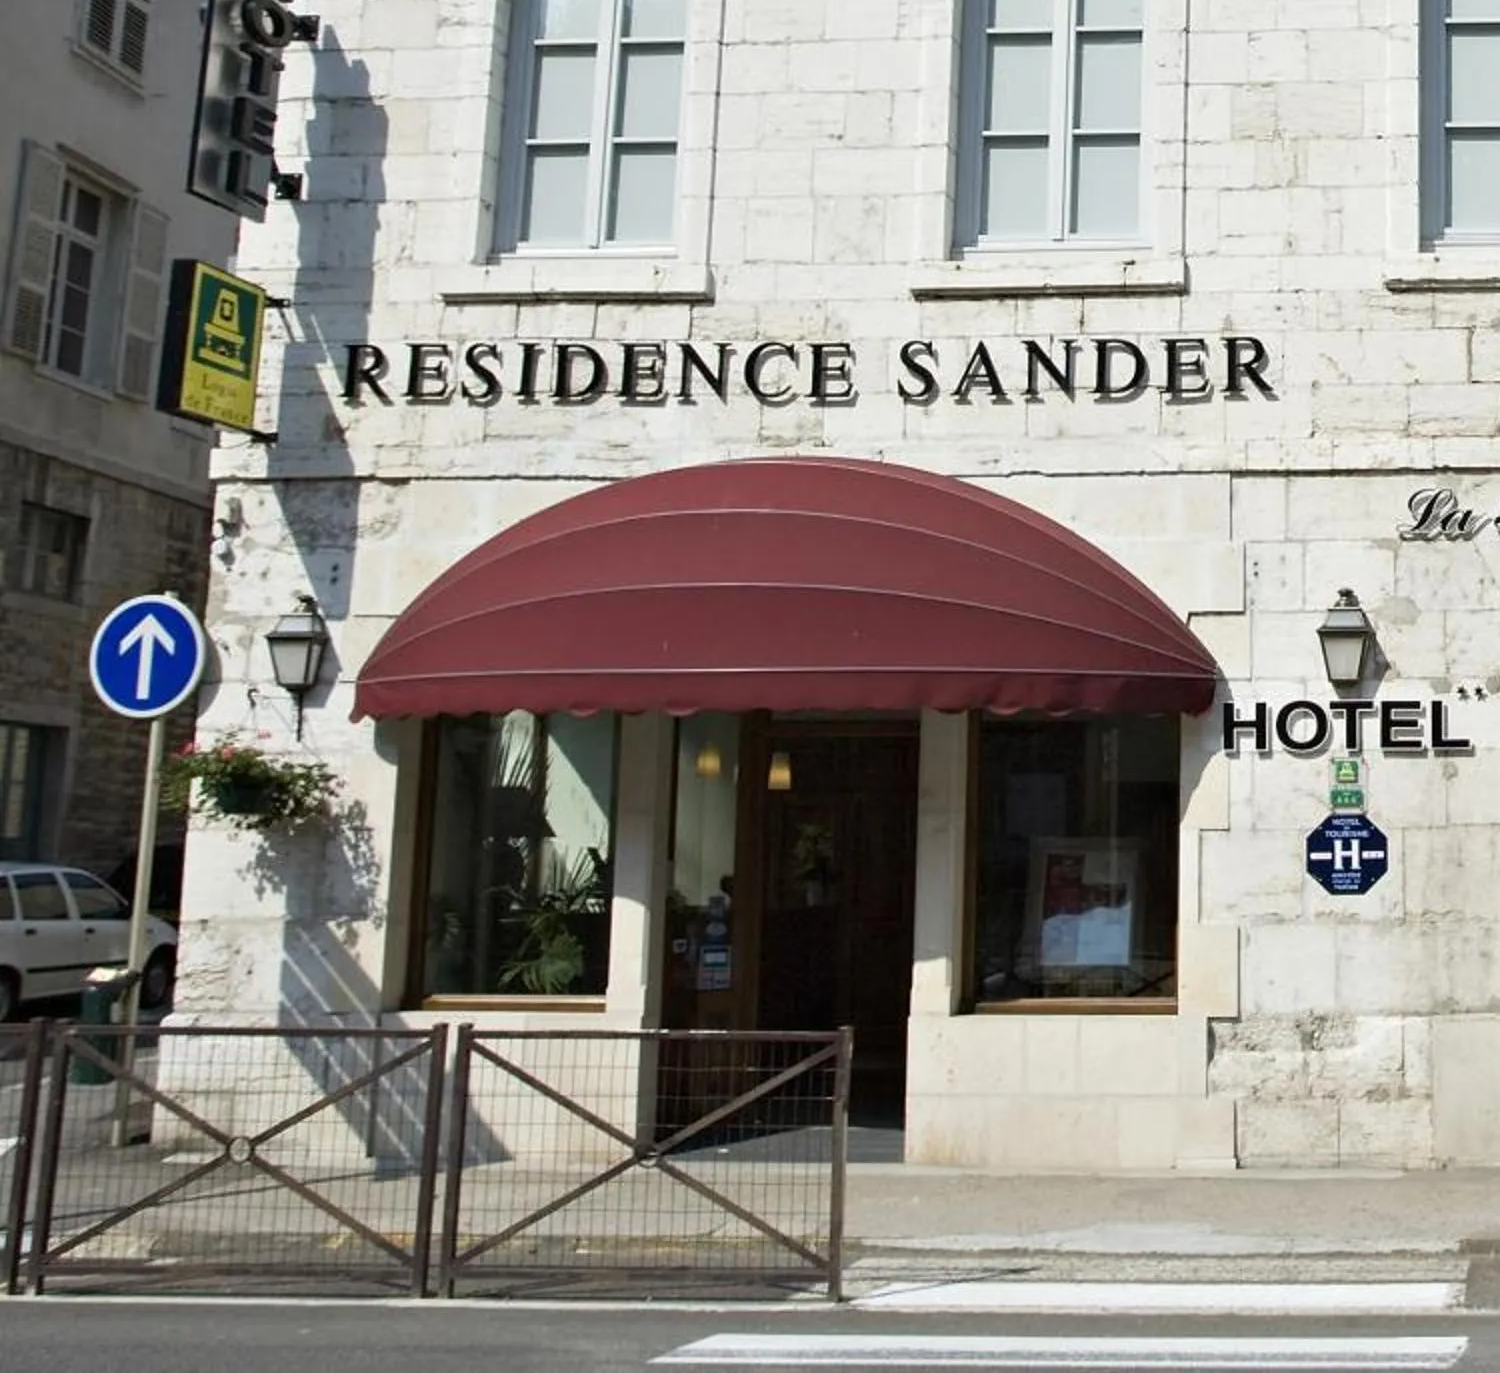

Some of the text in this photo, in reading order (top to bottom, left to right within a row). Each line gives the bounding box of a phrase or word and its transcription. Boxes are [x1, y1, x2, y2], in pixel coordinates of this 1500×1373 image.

[341, 335, 1276, 403] RESIDENCE SANDER
[1401, 487, 1484, 540] La
[1223, 700, 1471, 751] HOTEL
[1333, 838, 1361, 870] H
